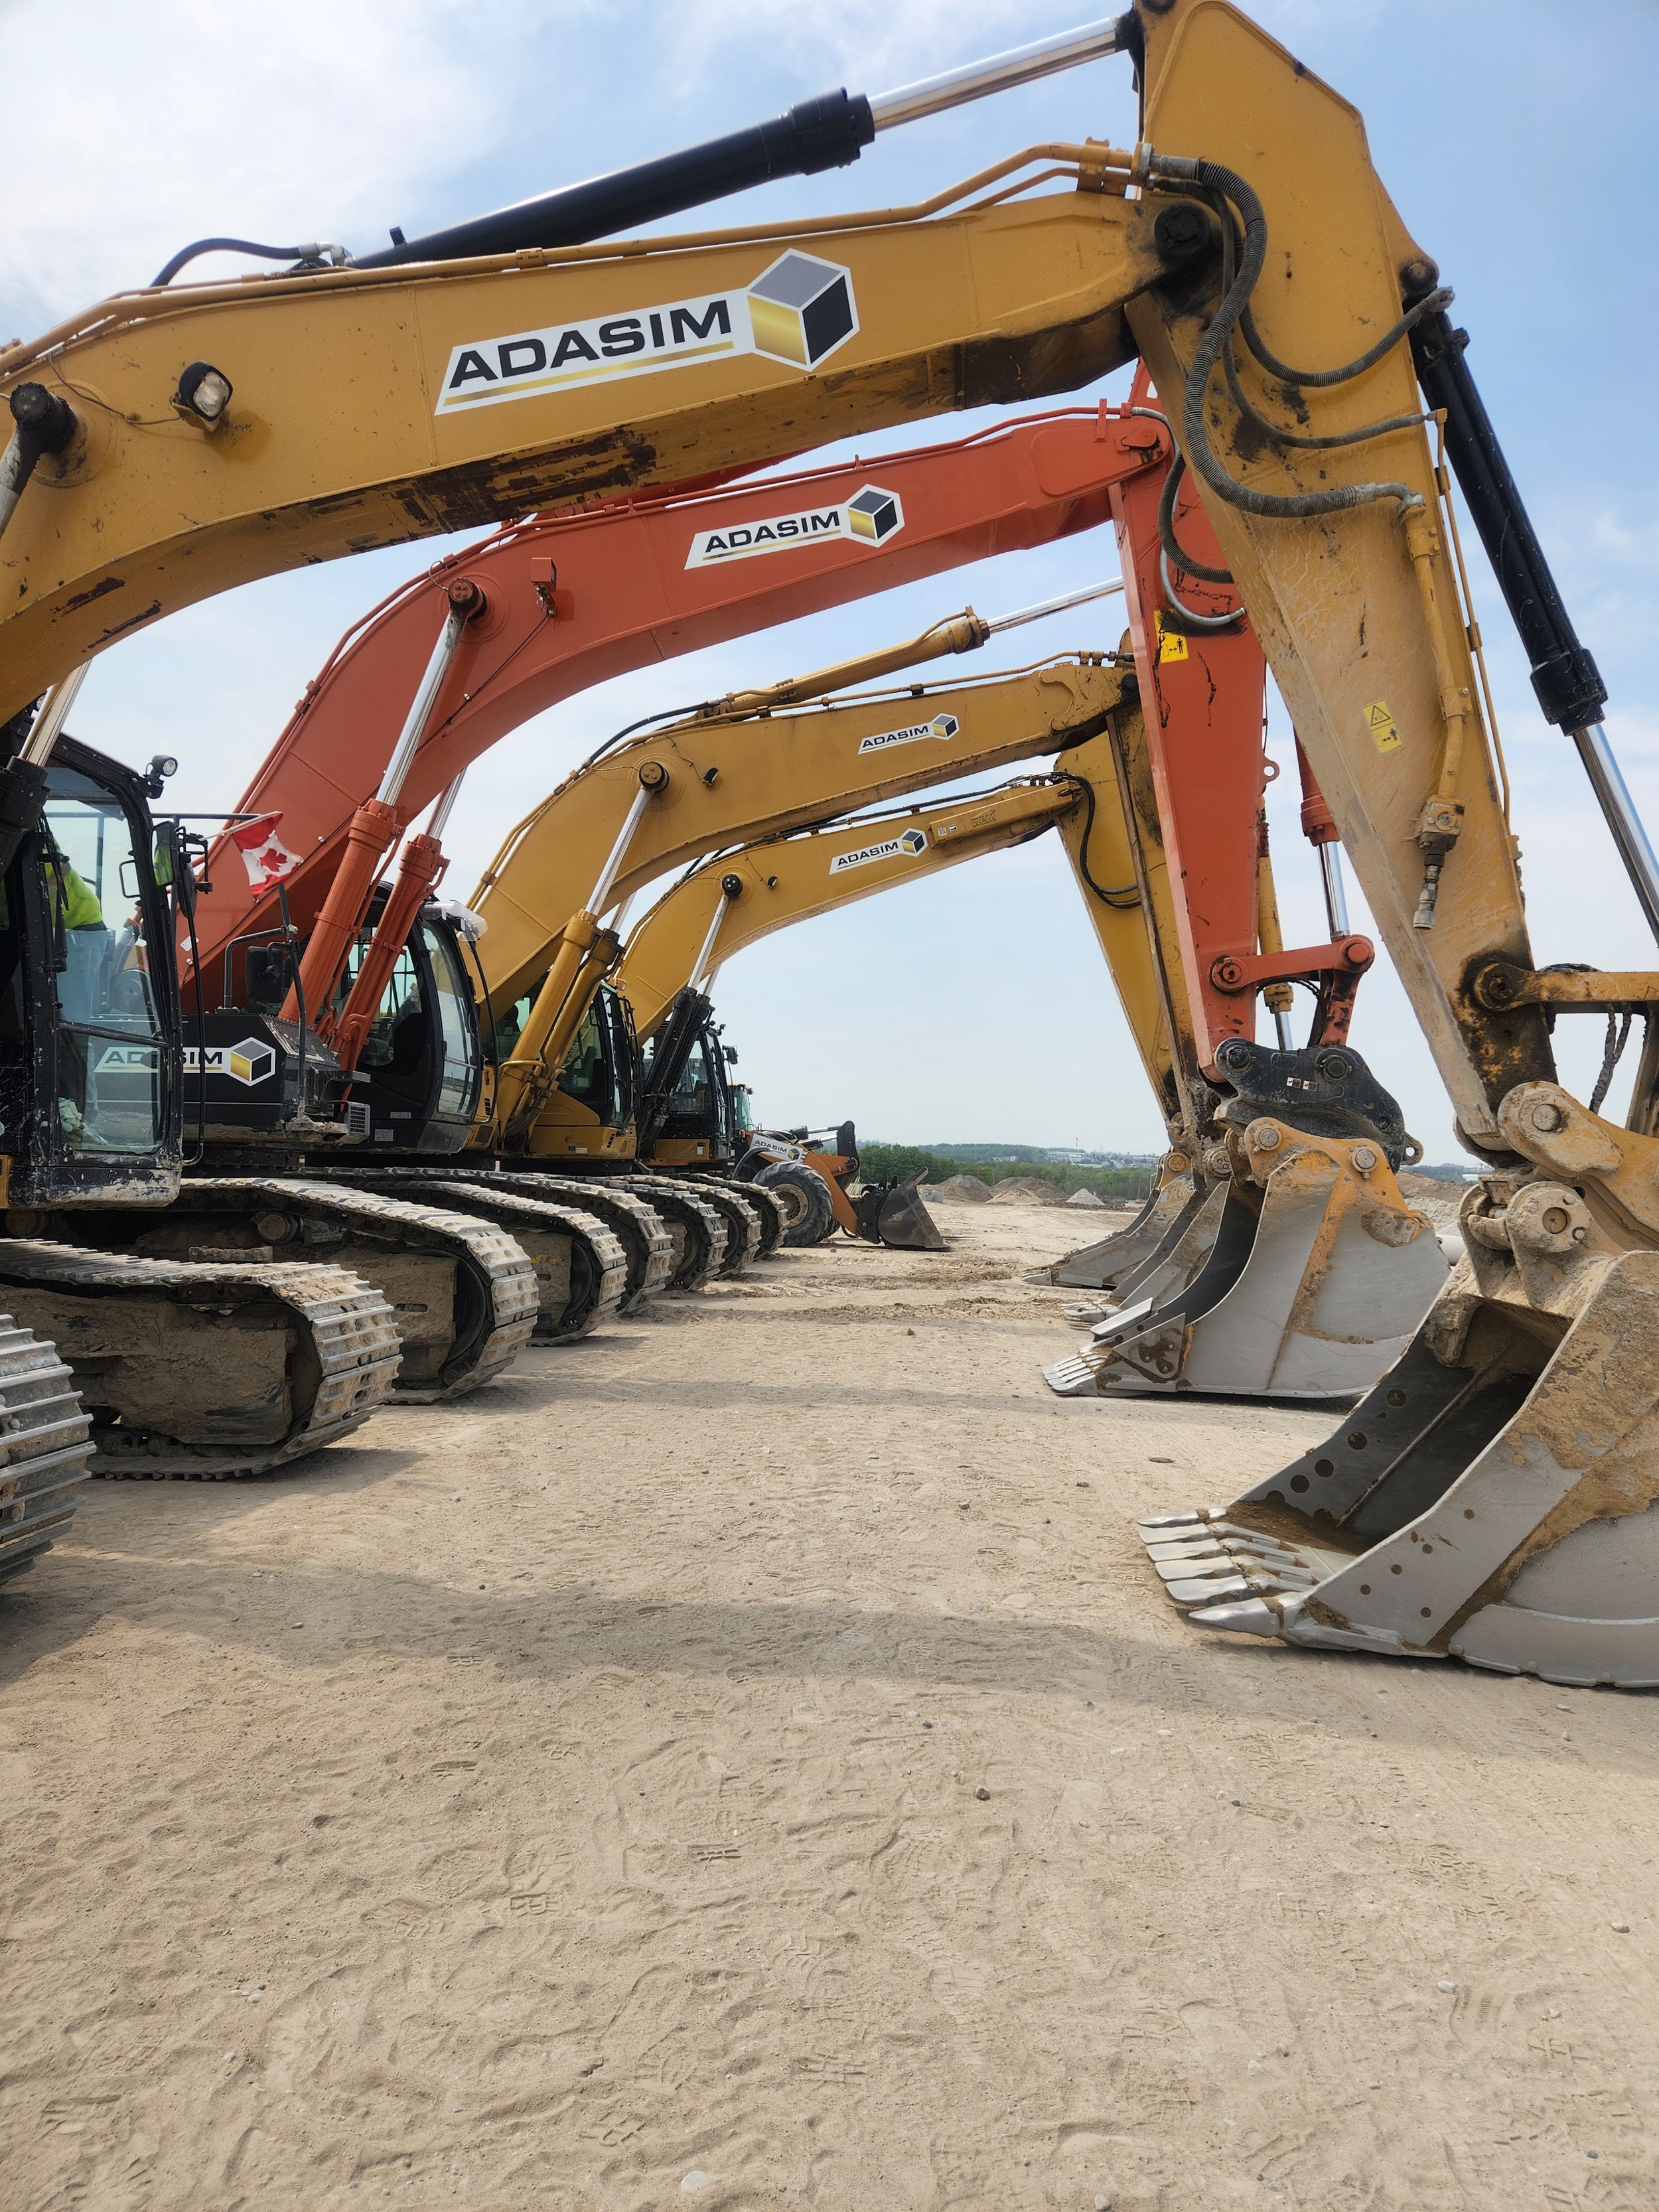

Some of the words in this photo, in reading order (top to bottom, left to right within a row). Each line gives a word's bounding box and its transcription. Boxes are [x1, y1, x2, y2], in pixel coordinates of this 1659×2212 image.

[449, 299, 731, 389] ADASIM
[705, 511, 840, 553] ADASIM
[862, 725, 929, 748] ADASIM
[837, 842, 899, 867] ADASIM
[105, 1051, 222, 1064] ADIM
[755, 1140, 787, 1153] ADASIM
